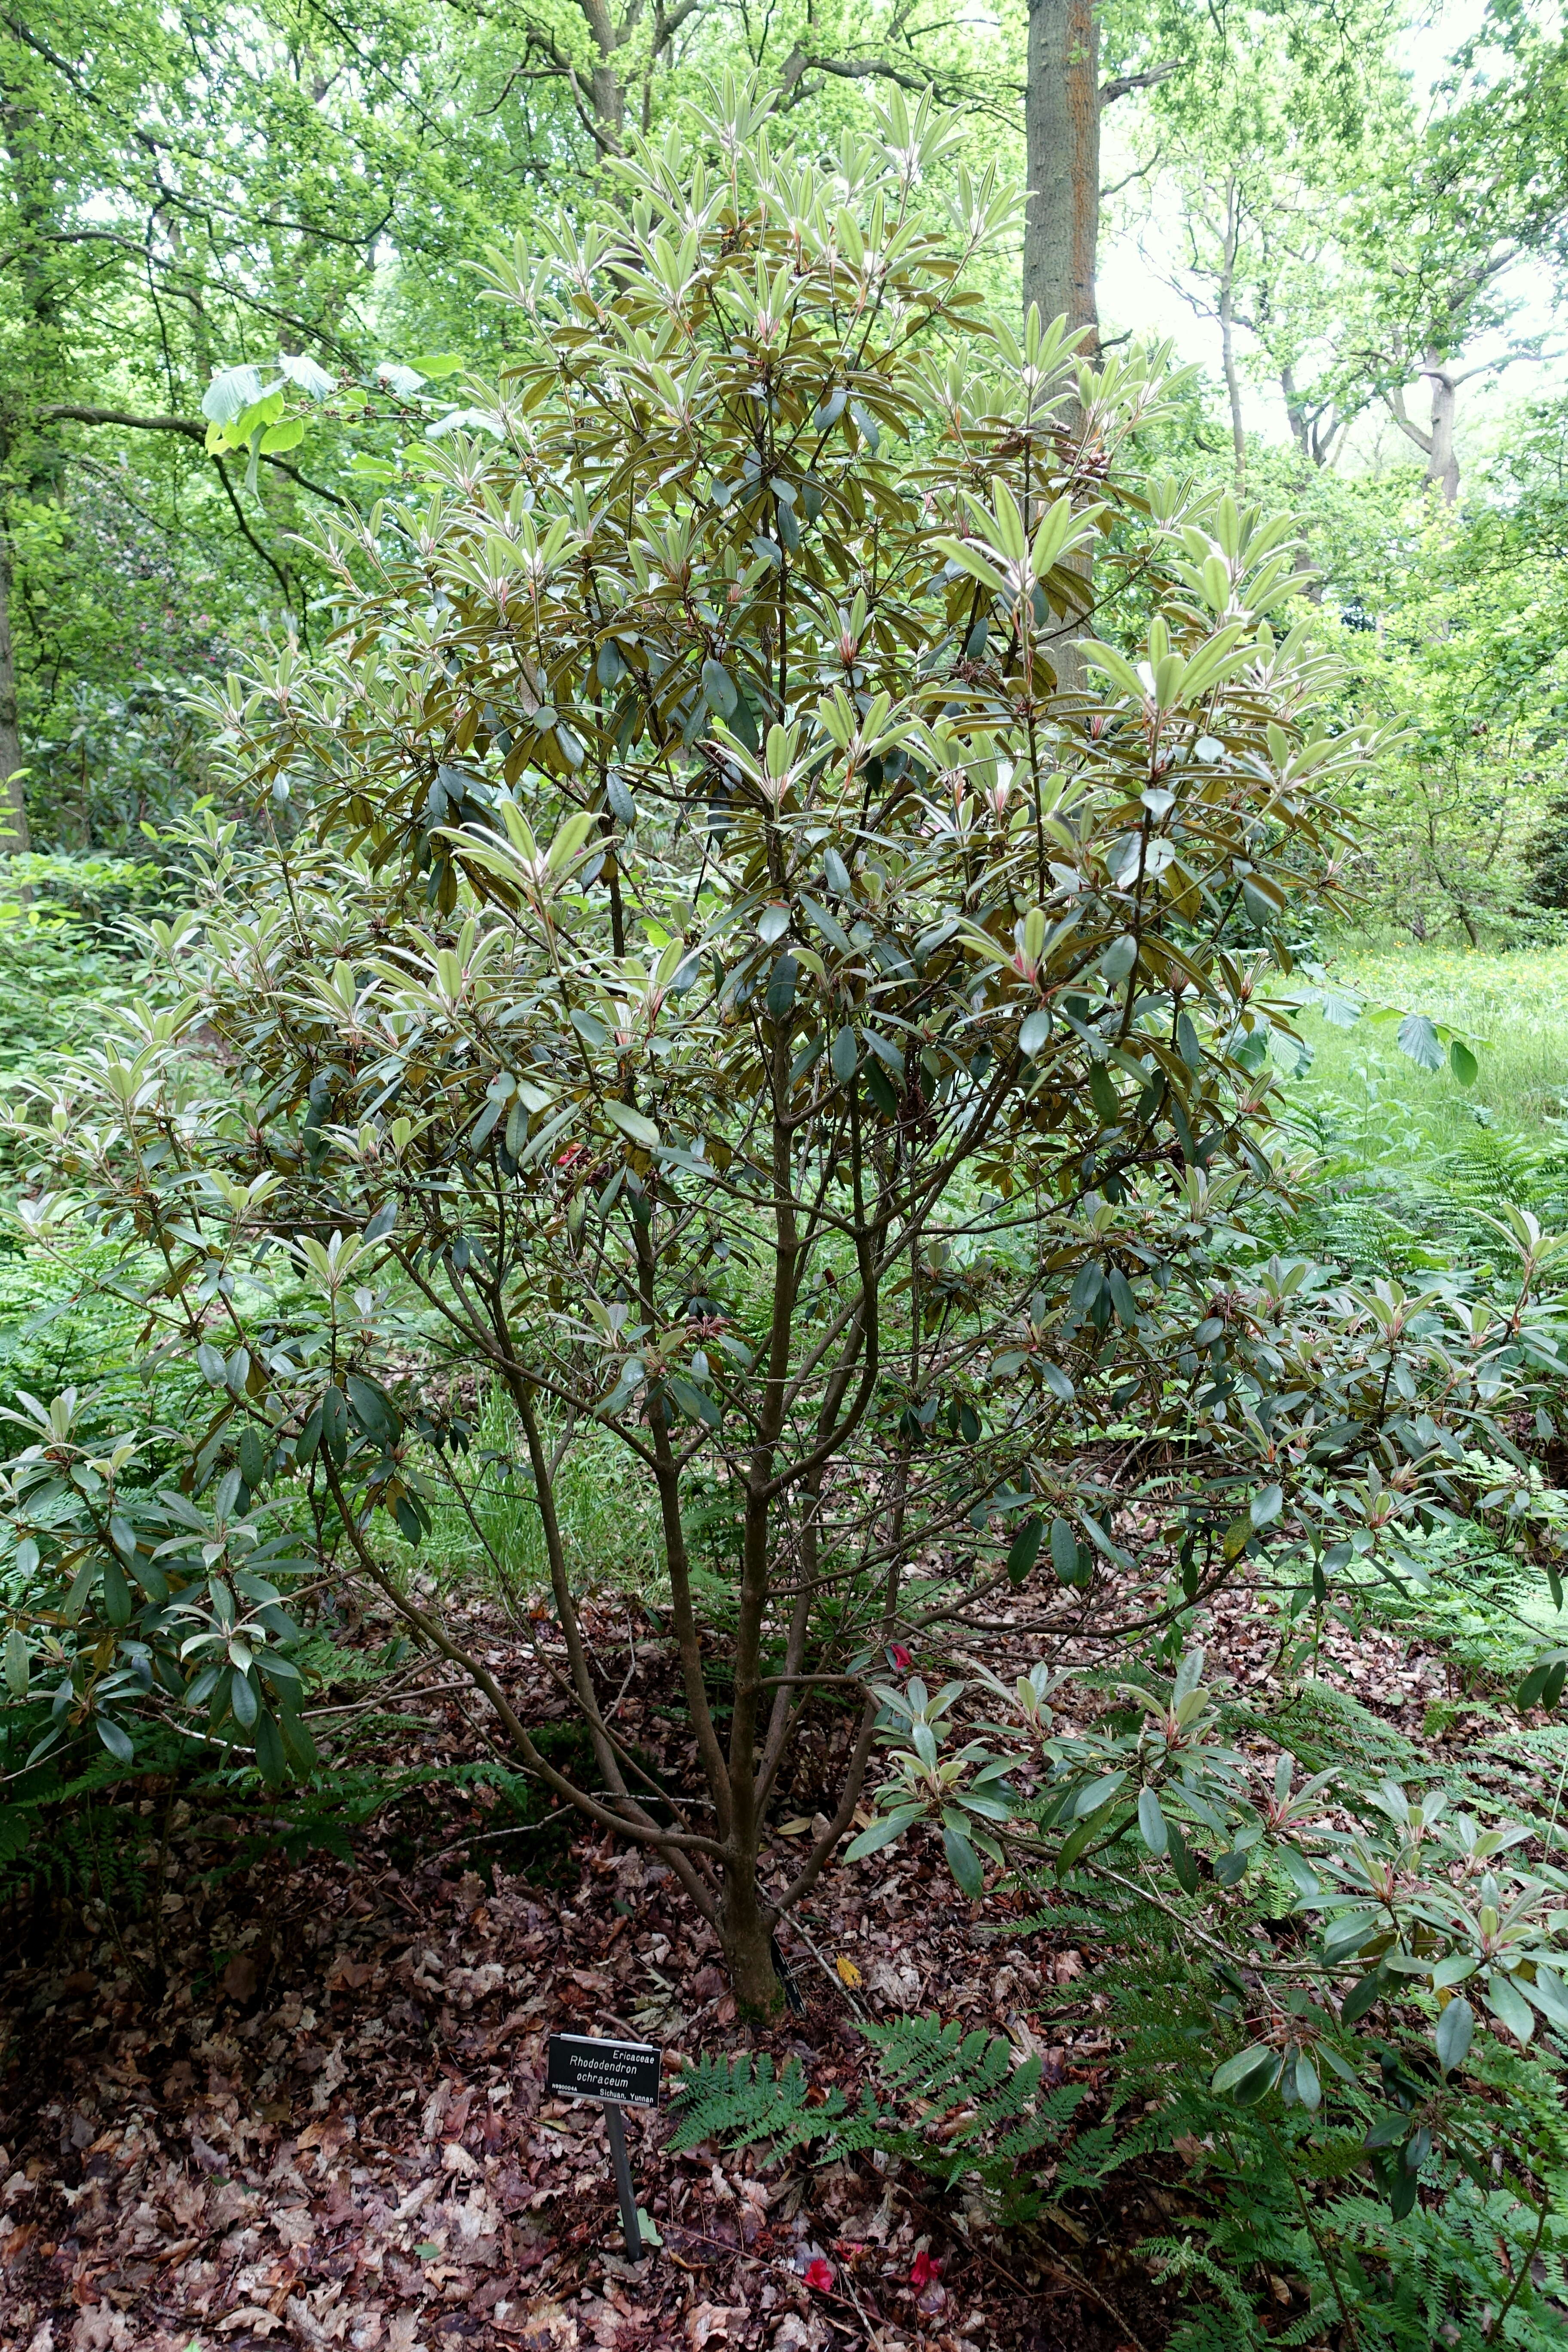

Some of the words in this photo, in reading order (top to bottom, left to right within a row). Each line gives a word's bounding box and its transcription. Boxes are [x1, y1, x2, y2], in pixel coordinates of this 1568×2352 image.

[613, 2050, 655, 2064] Ericaceae
[570, 2055, 637, 2074] Rhododendron
[577, 2072, 628, 2088] ochraceum
[552, 2083, 578, 2092] N990004A
[600, 2089, 626, 2100] Sichuan,
[630, 2093, 653, 2103] Yunnan
